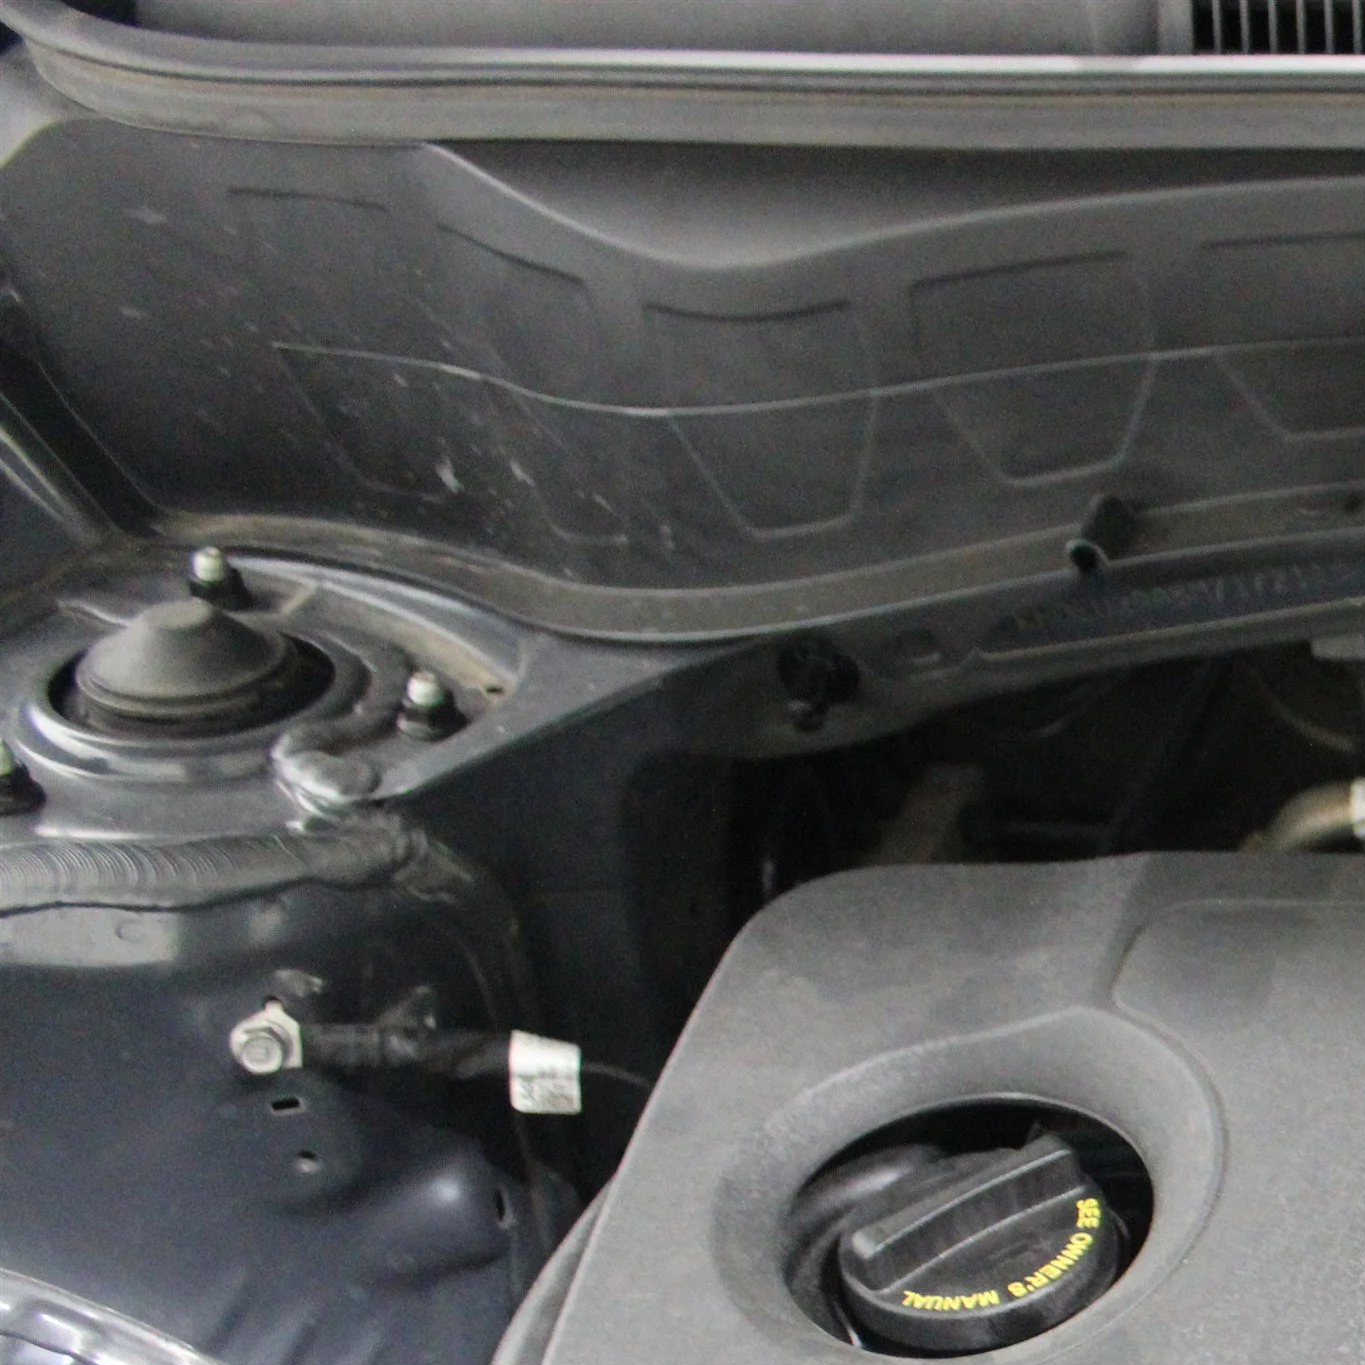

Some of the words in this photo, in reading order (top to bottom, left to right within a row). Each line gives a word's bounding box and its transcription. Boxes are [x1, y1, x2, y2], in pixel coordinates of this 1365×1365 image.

[1075, 1198, 1101, 1228] SEE
[1007, 1232, 1094, 1298] OWNER'S
[902, 1290, 999, 1311] MANUAL
